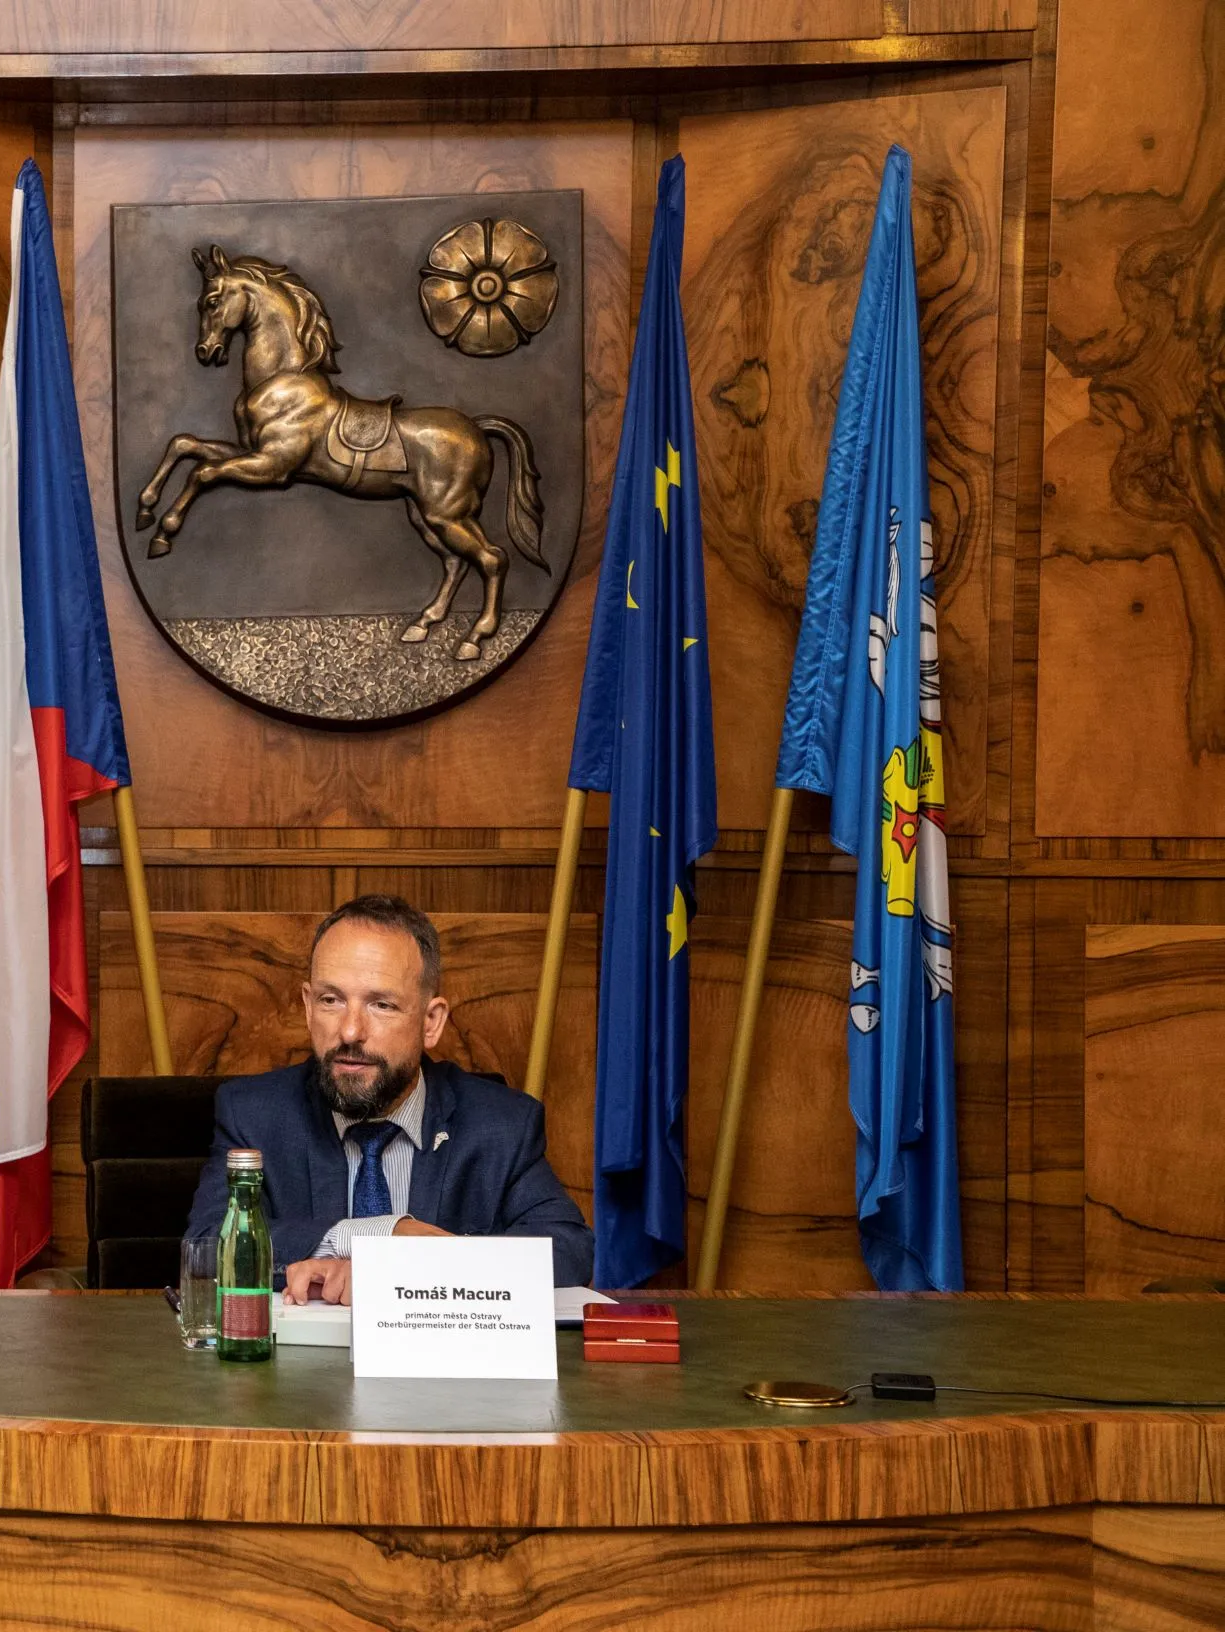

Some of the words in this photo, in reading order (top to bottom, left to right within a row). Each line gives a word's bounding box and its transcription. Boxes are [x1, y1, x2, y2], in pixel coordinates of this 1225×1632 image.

[394, 1286, 448, 1301] Tomáš
[452, 1287, 512, 1302] Macura
[404, 1311, 441, 1321] primátor
[443, 1311, 468, 1320] města
[470, 1312, 503, 1322] Ostravy
[376, 1320, 456, 1330] Oberbürgermeister
[458, 1321, 473, 1330] der
[474, 1321, 497, 1330] Stadt
[498, 1322, 531, 1331] Ostrava
